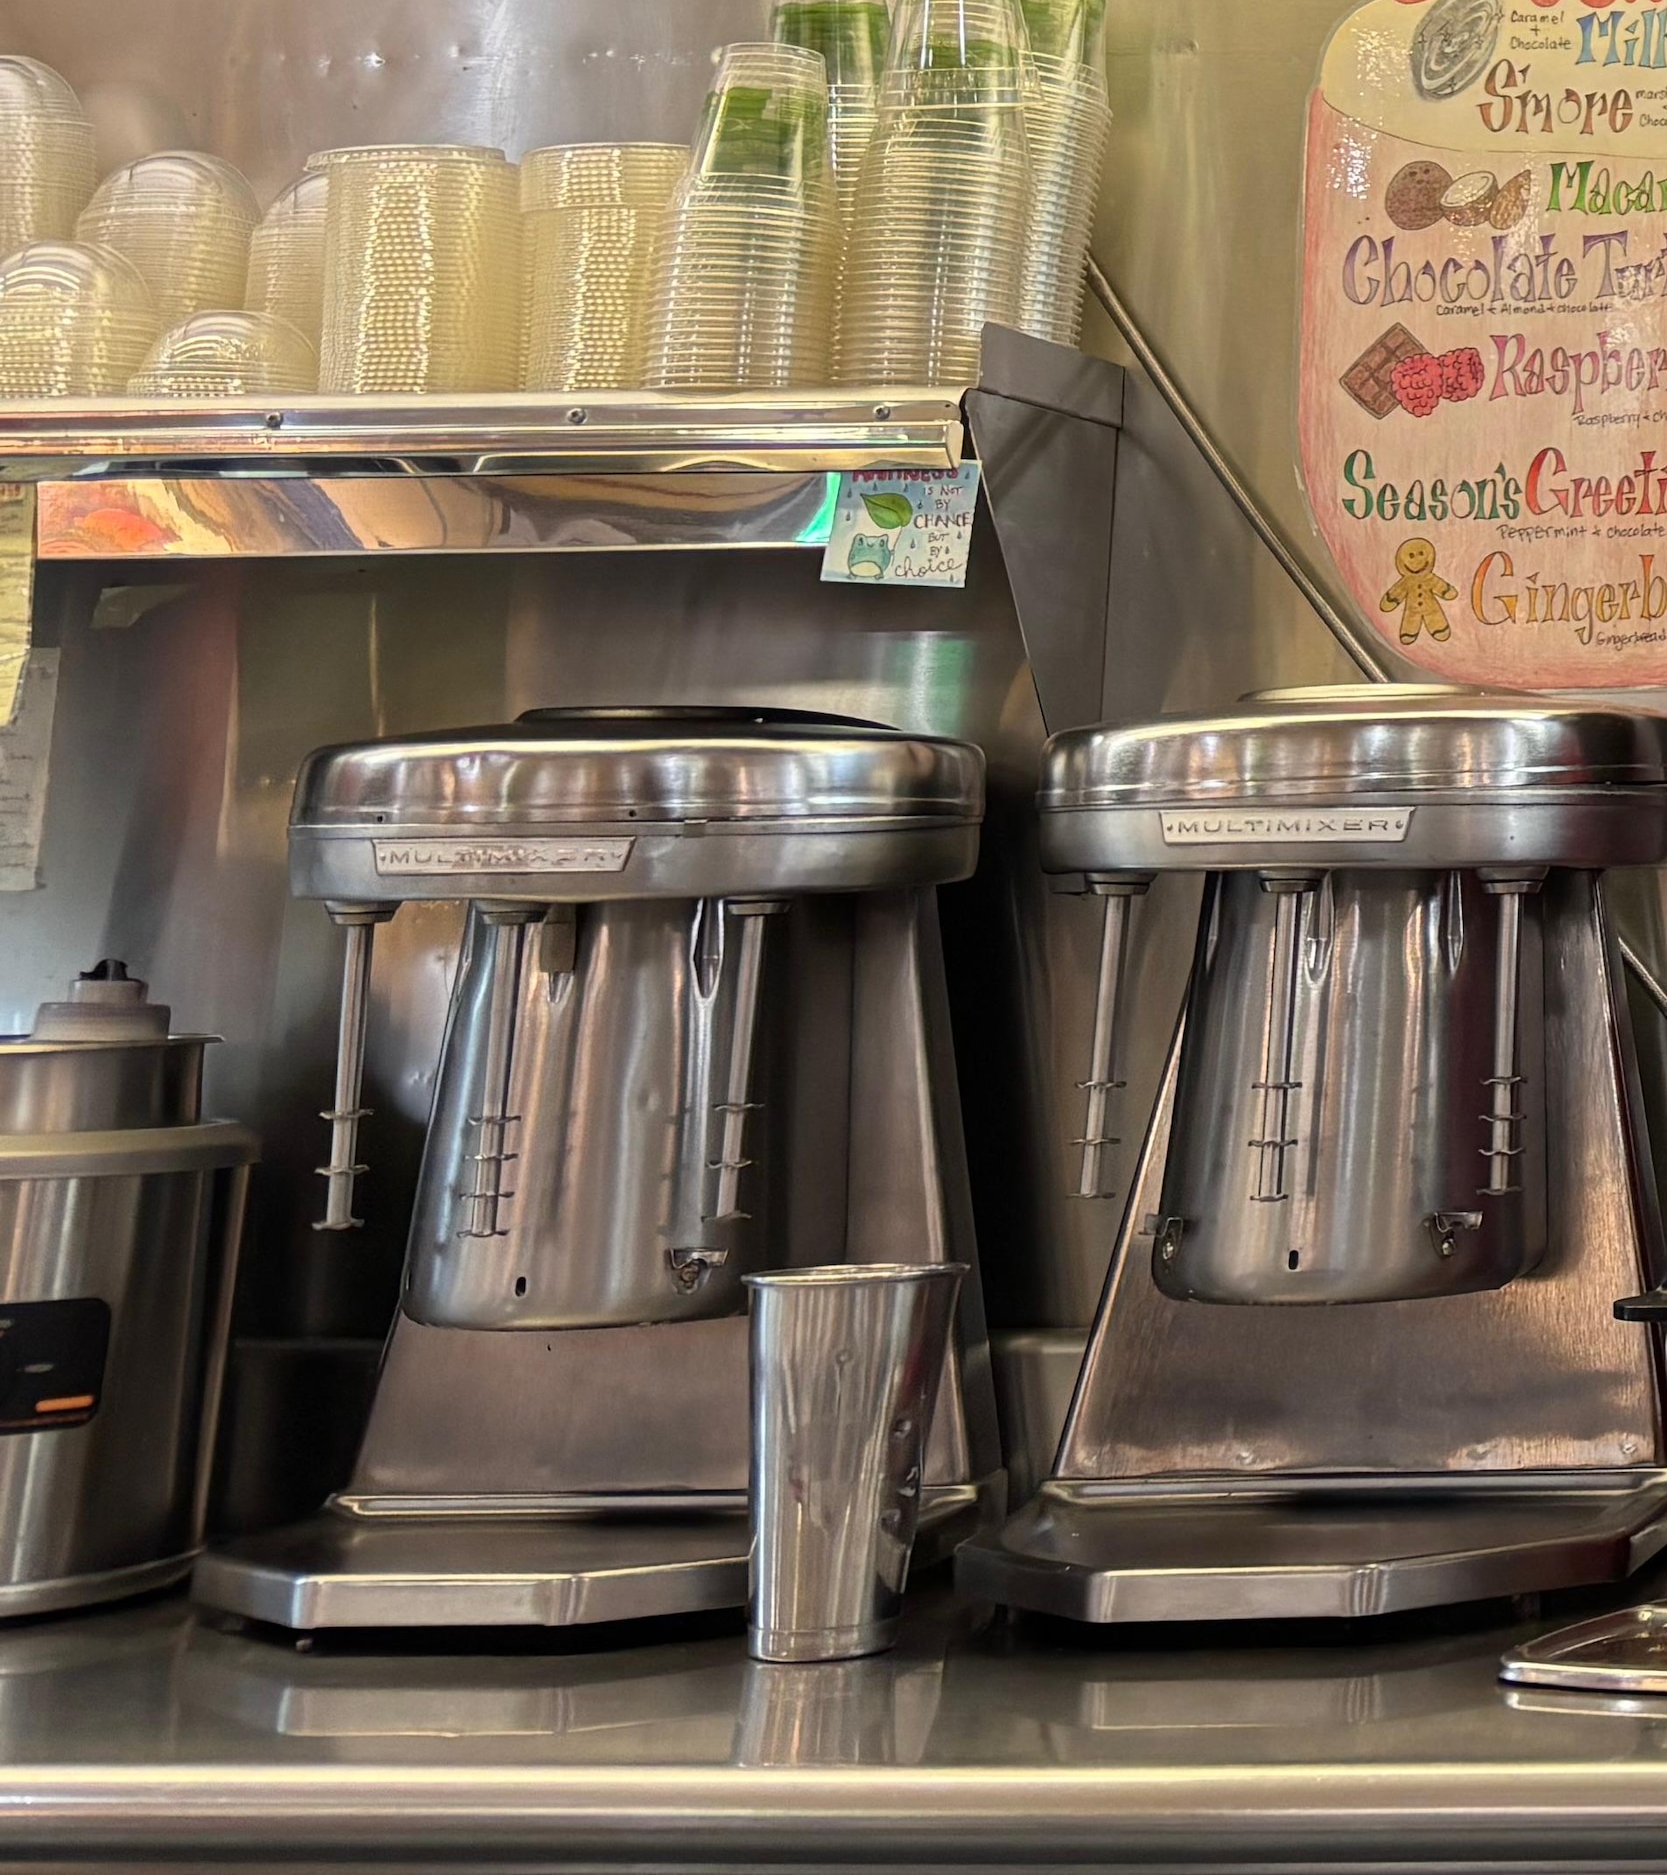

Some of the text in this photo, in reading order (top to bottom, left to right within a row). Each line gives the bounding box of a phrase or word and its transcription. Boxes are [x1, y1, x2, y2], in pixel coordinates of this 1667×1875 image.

[1510, 9, 1565, 25] Caramel
[1510, 35, 1573, 51] Chocolate
[1341, 233, 1579, 308] Chocolate
[1435, 303, 1485, 316] Caramel
[1341, 448, 1523, 521] Season's
[913, 511, 972, 530] CHANCE
[1495, 523, 1667, 543] Peppermint chocolate
[894, 555, 963, 580] choice
[1175, 815, 1391, 835] MULTIMIXER
